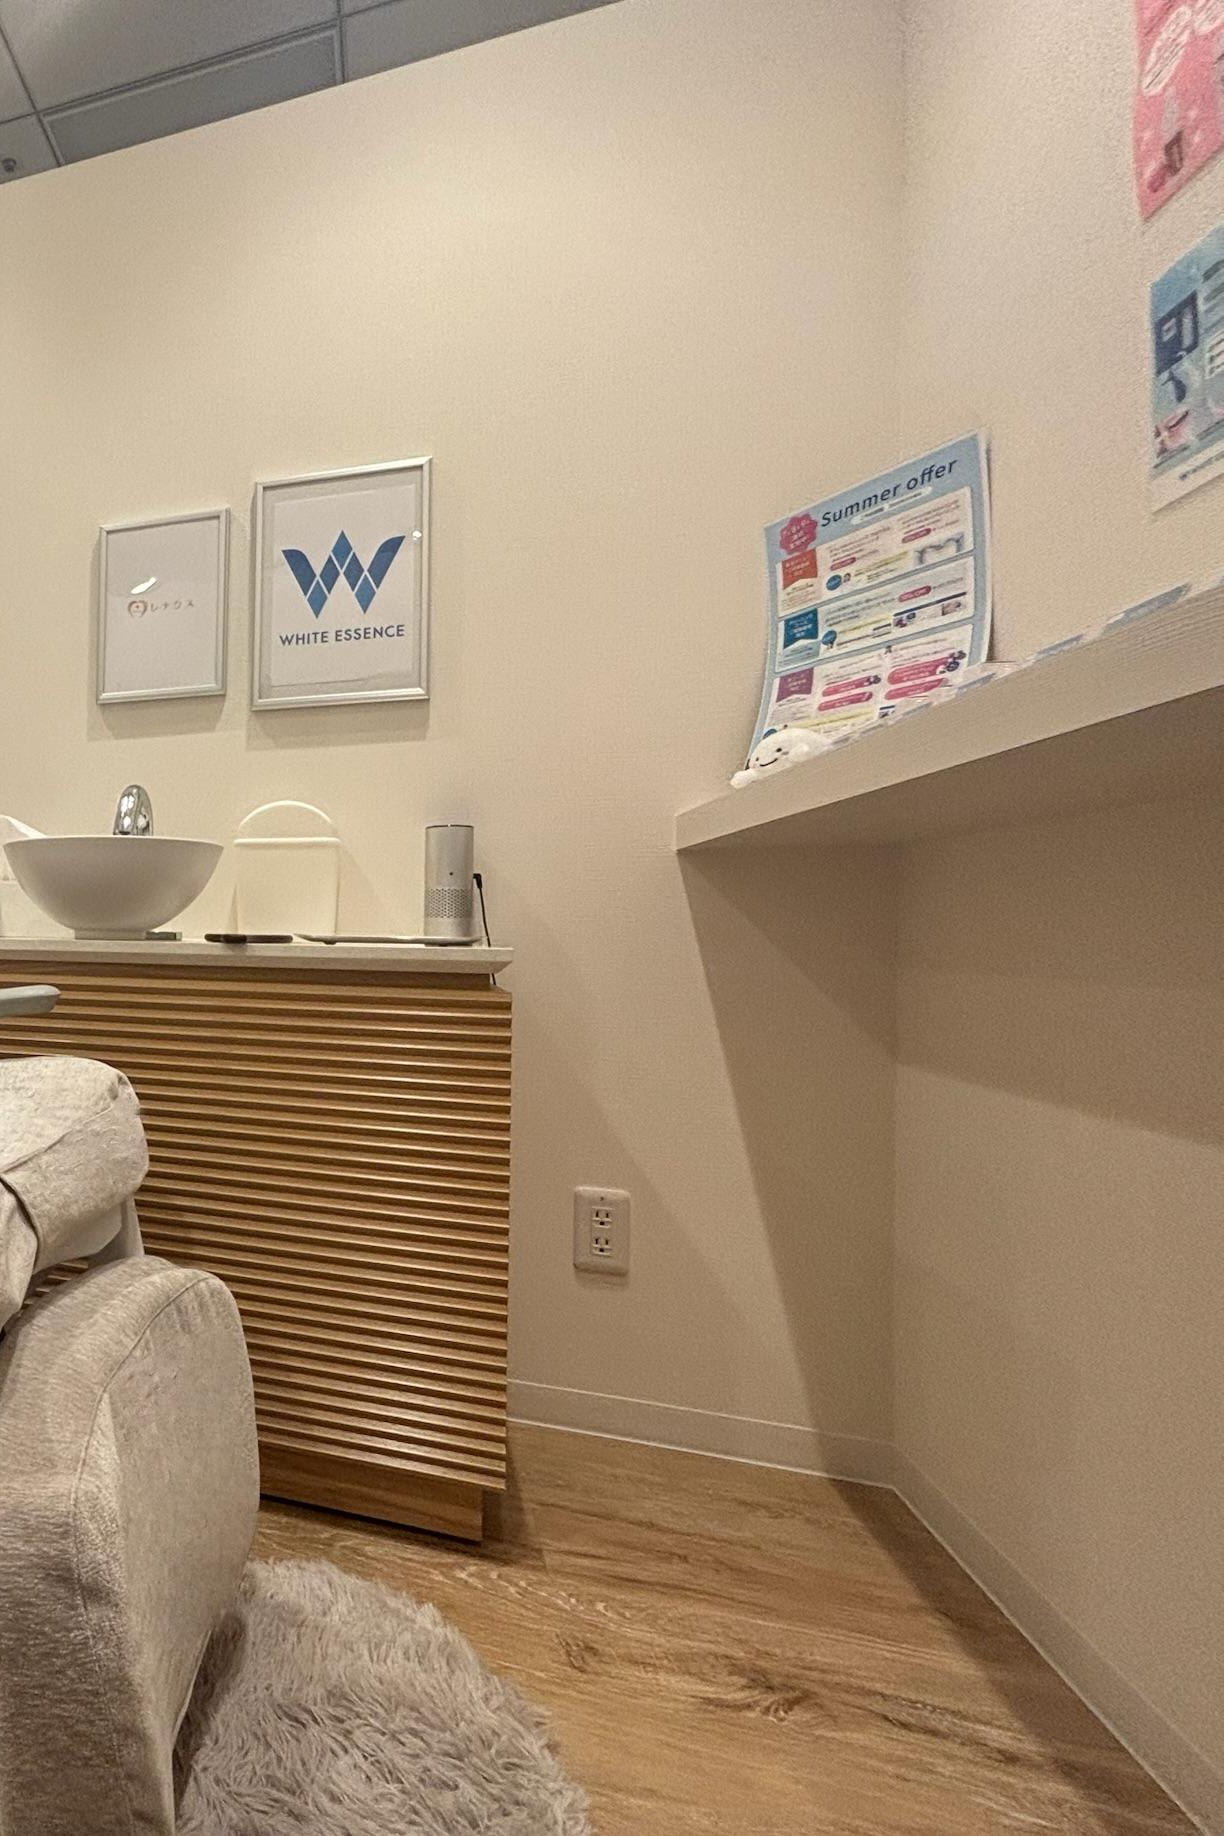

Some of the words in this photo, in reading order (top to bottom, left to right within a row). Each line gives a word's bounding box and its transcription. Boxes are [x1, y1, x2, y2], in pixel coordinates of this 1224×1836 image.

[821, 482, 902, 527] Summer
[906, 459, 958, 491] offer
[279, 631, 329, 646] WHITE
[334, 624, 406, 642] ESSENCE
